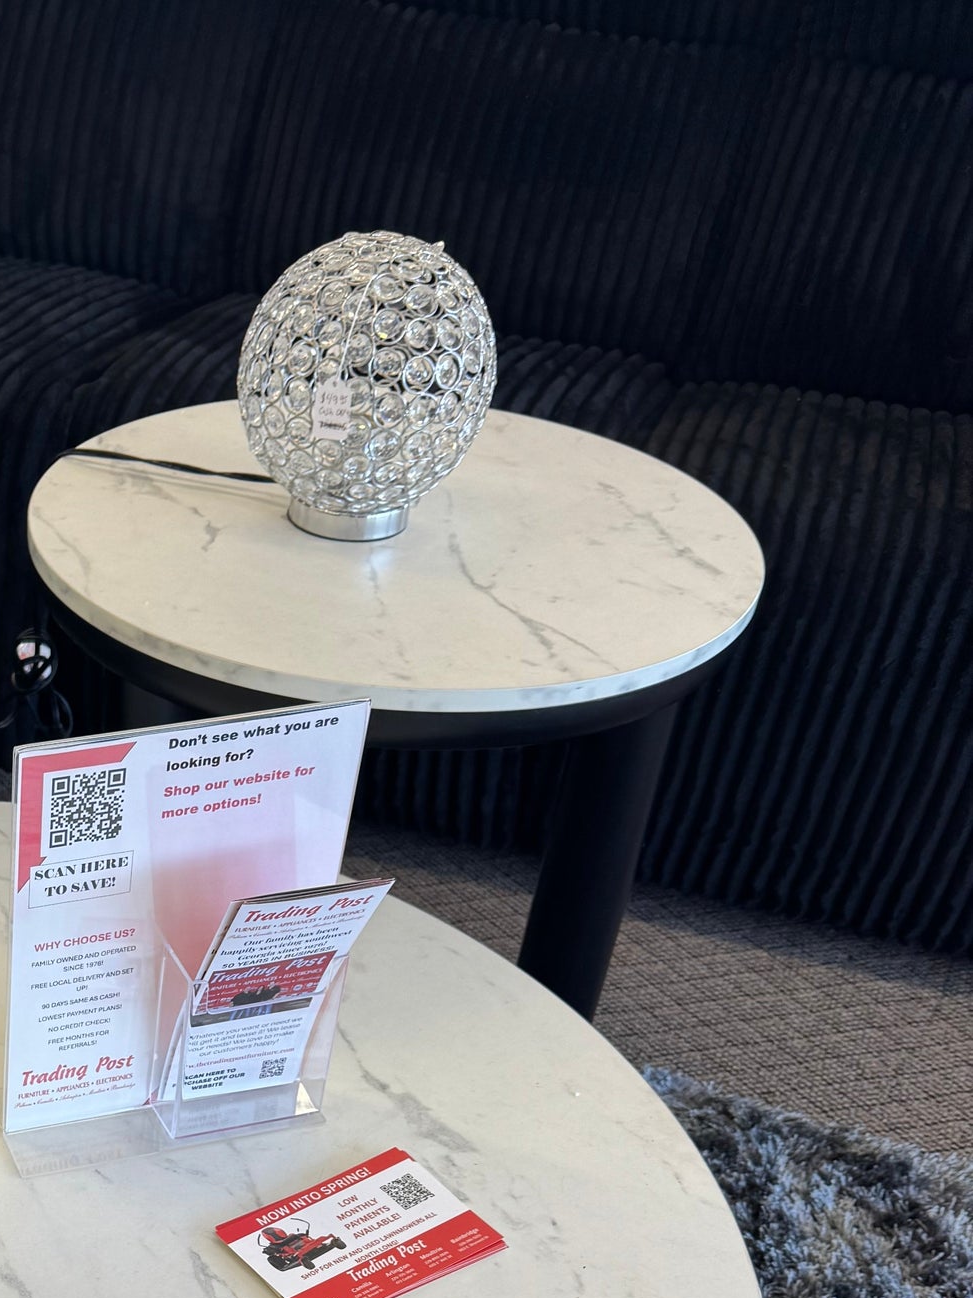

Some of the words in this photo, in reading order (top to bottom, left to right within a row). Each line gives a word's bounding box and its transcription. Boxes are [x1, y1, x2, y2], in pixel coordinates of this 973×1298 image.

[168, 734, 208, 750] Don't
[211, 731, 239, 743] see
[243, 723, 281, 739] what
[283, 721, 311, 736] you
[314, 716, 340, 728] are
[166, 756, 221, 772] looking
[225, 748, 254, 763] for?
[163, 784, 201, 798] Shop
[204, 779, 229, 791] our
[233, 769, 291, 787] website
[294, 766, 316, 777] for
[161, 805, 199, 819] more
[203, 793, 262, 813] options!
[34, 864, 77, 881] SCAN
[80, 856, 129, 874] HERE
[44, 884, 68, 897] TO
[70, 876, 116, 893] SAVE!
[244, 904, 323, 922] Trading
[329, 894, 374, 911] Post
[34, 940, 61, 953] WHY
[63, 931, 112, 948] CHOOSE
[114, 928, 136, 939] US?
[31, 958, 56, 968] FAMILY
[55, 954, 84, 964] OWNED
[83, 951, 100, 959] AND
[100, 945, 137, 957] OPERATED
[62, 963, 84, 973] SINCE
[85, 959, 104, 969] 1976!
[238, 957, 268, 967] YEARS
[47, 1025, 60, 1033] NO
[59, 1021, 85, 1031] CREDIT
[84, 1017, 111, 1027] CHECK!
[22, 1064, 89, 1087] Trading
[95, 1054, 135, 1073] Post
[255, 1204, 290, 1226] MOW
[288, 1191, 322, 1210] INTO
[320, 1166, 372, 1195] SPRING!
[337, 1194, 359, 1208] LOW
[335, 1197, 378, 1222] MONTHLY
[343, 1205, 391, 1231] PAYMENTS
[353, 1212, 402, 1240] AVAILABLE!
[300, 1268, 320, 1281] SHOP
[318, 1261, 335, 1272] FOR
[332, 1254, 349, 1265] NEW
[348, 1247, 364, 1258] AND
[361, 1239, 381, 1251] USED
[379, 1217, 426, 1242] LAWNMOWERS
[424, 1211, 438, 1221] ALL
[354, 1249, 380, 1264] MONTH
[377, 1239, 400, 1252] LONG!
[346, 1254, 398, 1282] Trading
[396, 1239, 427, 1258] Post
